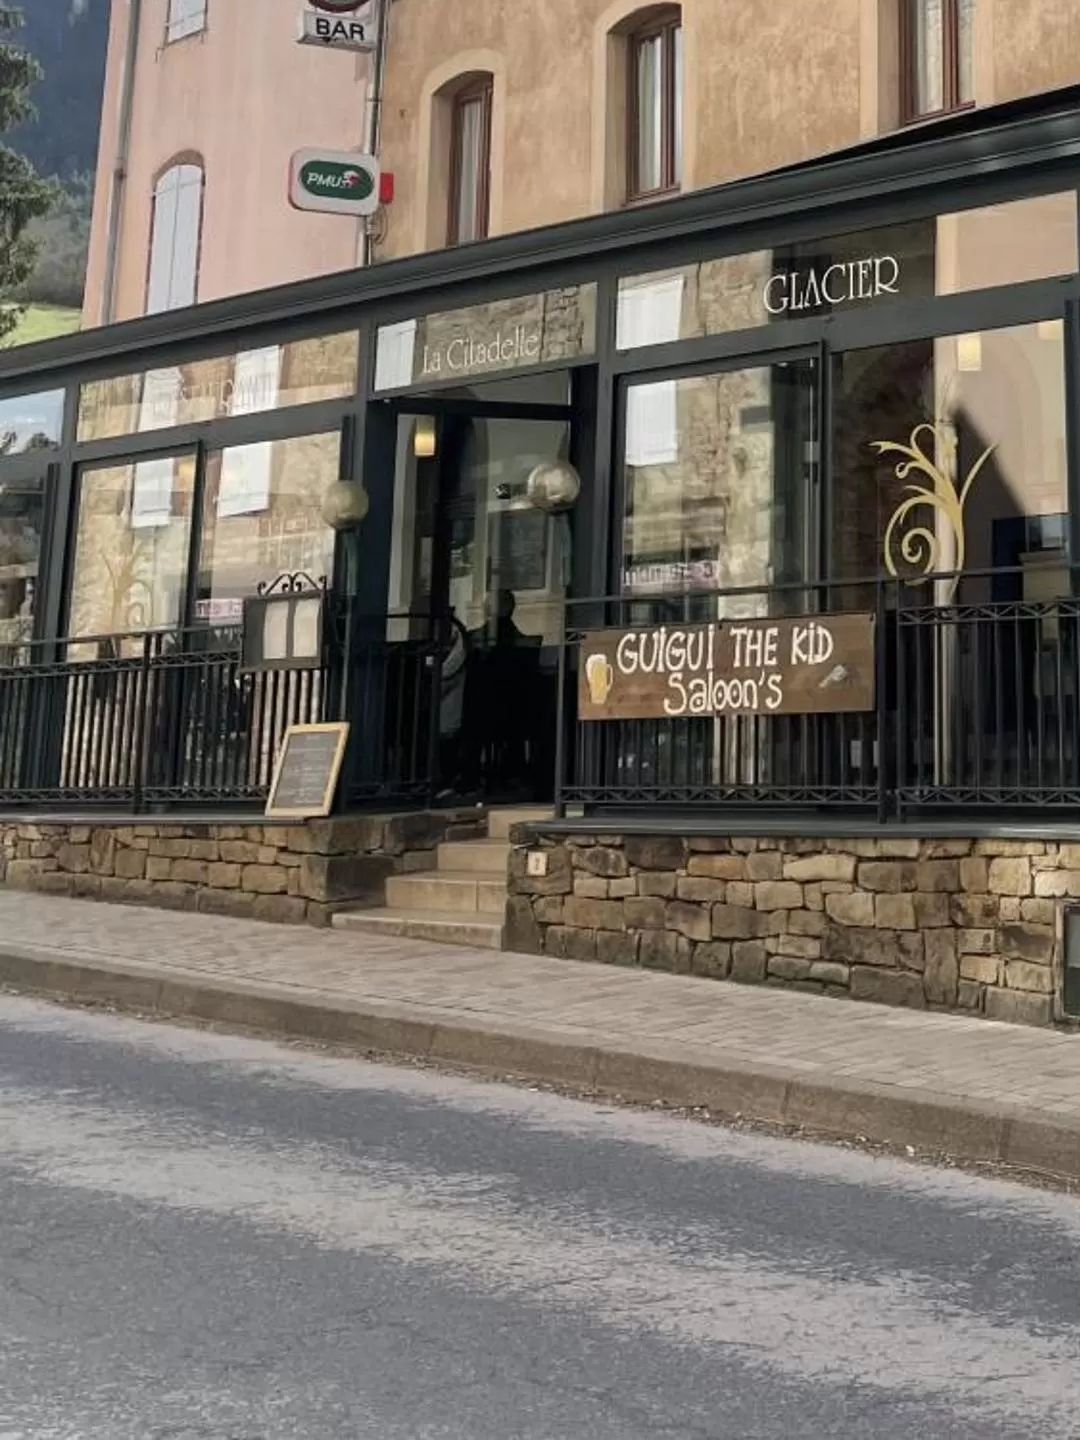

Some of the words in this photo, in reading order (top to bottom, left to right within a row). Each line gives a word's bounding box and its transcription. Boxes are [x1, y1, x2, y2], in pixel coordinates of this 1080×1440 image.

[315, 17, 366, 41] BAR
[306, 171, 343, 189] PMU
[763, 256, 899, 314] GLACIER
[422, 343, 441, 373] La
[446, 324, 539, 370] Citadelle
[730, 626, 779, 668] THE
[663, 668, 783, 715] Saloon's
